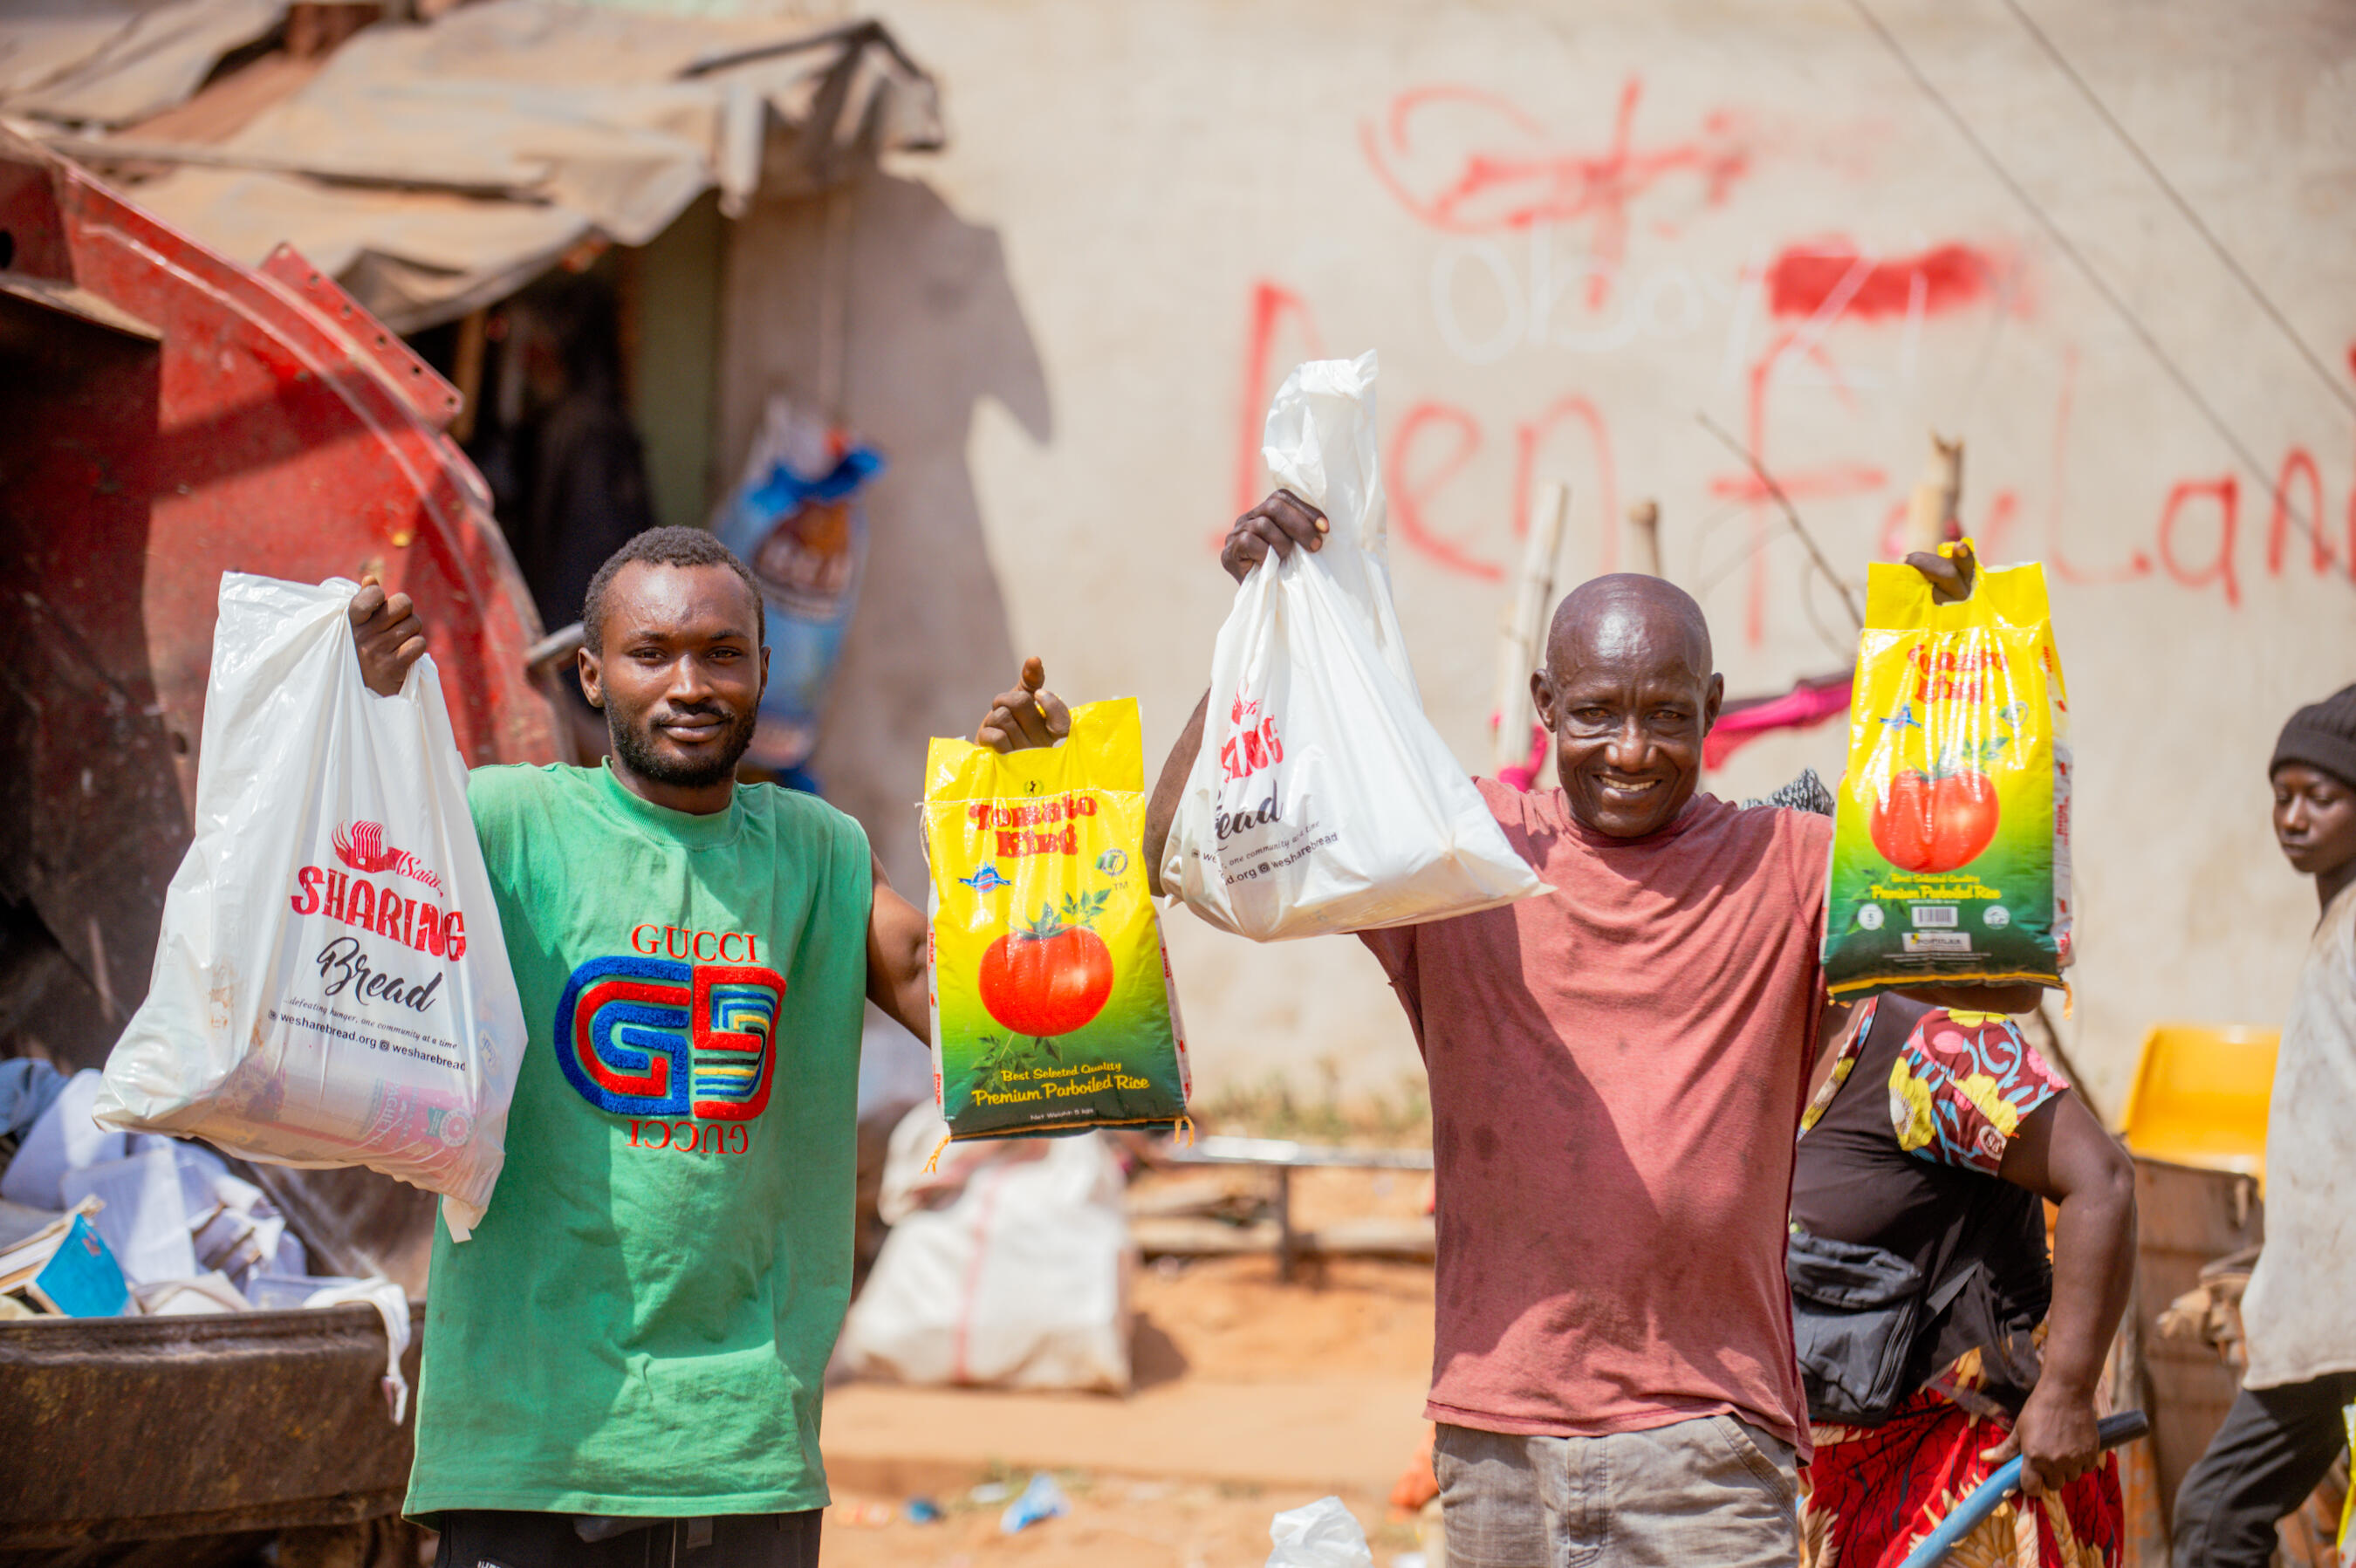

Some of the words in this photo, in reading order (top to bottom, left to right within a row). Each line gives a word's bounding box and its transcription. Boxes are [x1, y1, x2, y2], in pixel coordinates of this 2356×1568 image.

[969, 794, 1098, 831] Tomato
[1246, 840, 1290, 860] community
[1270, 832, 1339, 867] wesharebread
[291, 866, 467, 962] SHARING
[631, 924, 761, 962] GUCCI
[316, 936, 443, 1012] Bread
[280, 1012, 377, 1049] wesharebread.org
[392, 1044, 466, 1072] wesharebread
[329, 1007, 358, 1024] hunger,
[360, 1017, 375, 1027] one
[377, 1022, 421, 1041] community
[421, 1035, 431, 1044] at
[439, 1038, 458, 1050] time
[971, 1089, 1043, 1106] Premium
[1041, 1074, 1114, 1099] Parboiled
[1113, 1074, 1151, 1091] Rice
[1001, 1070, 1031, 1082] Best
[1033, 1065, 1079, 1080] Selected
[1080, 1061, 1122, 1073] Quality
[626, 1120, 749, 1154] GUCCI
